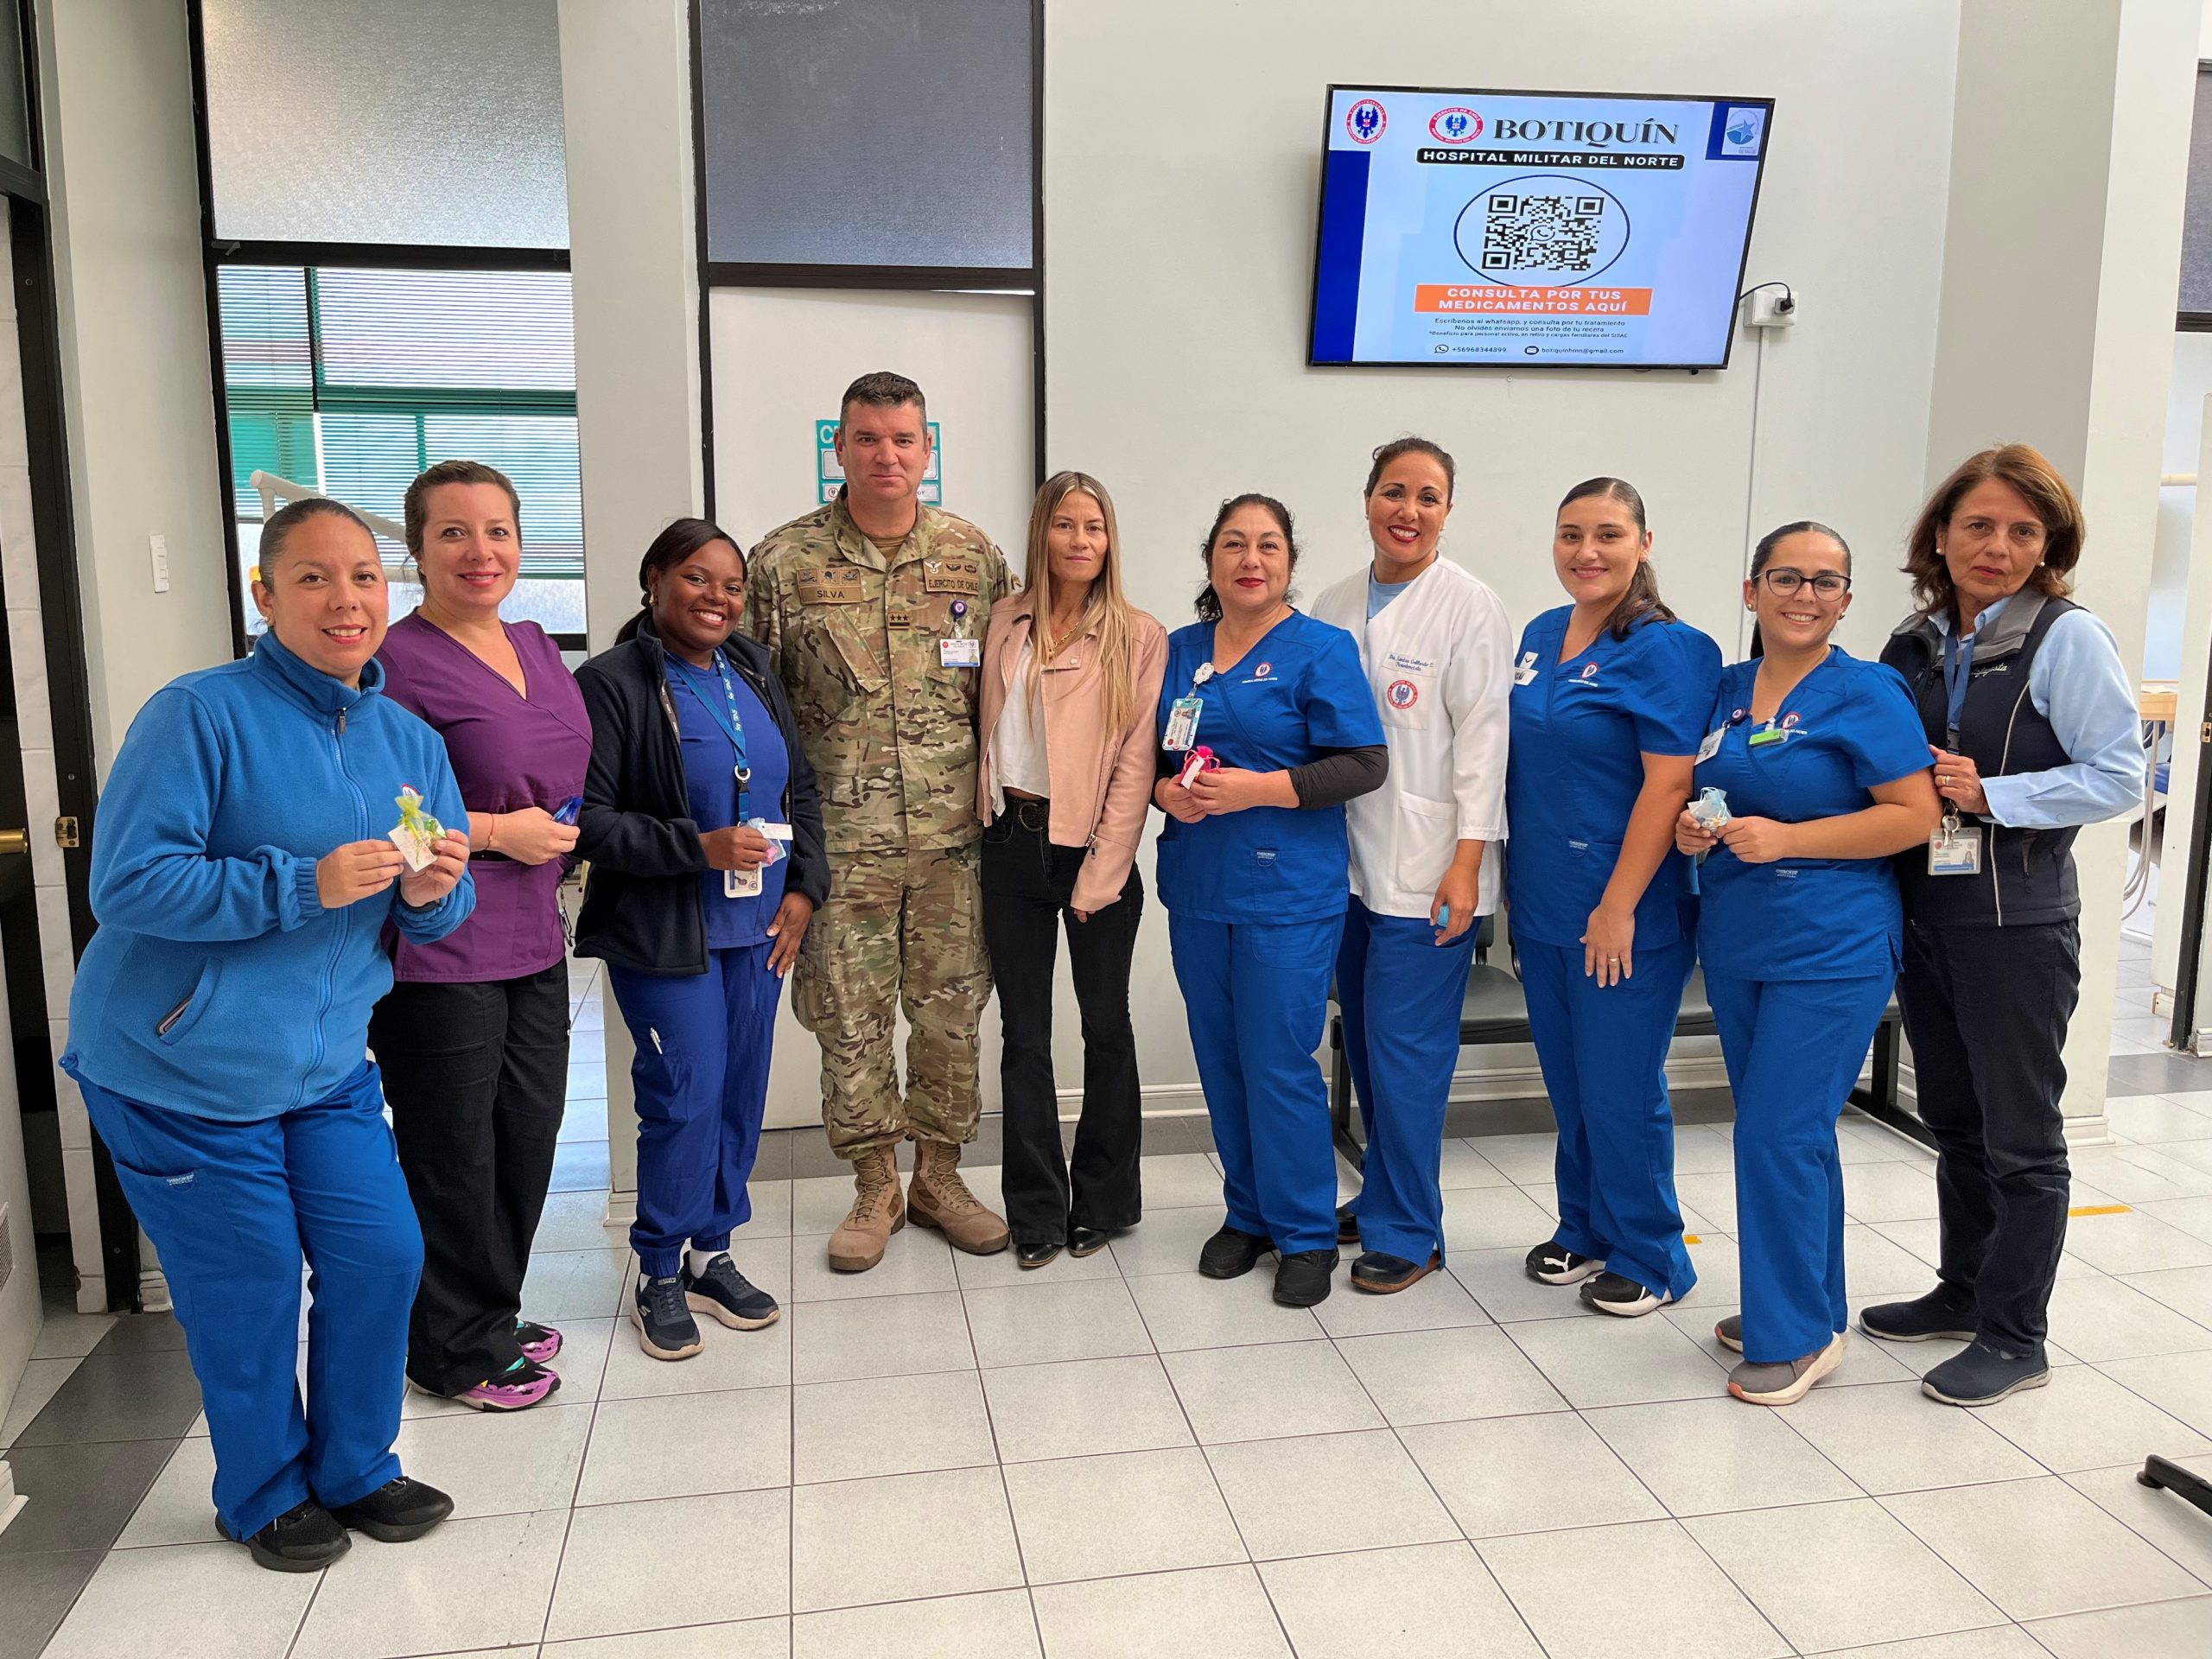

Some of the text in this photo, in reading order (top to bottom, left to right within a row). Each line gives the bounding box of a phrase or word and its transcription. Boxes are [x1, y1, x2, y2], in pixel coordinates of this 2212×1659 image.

[1493, 118, 1679, 148] BOTIQUÍN
[1423, 150, 1679, 167] HOSPITAL MILITAR DEL NORTE
[1446, 288, 1622, 300] CONSULTA POR TUS
[1439, 300, 1628, 312] MEDICAMENTOS AQUÍ
[928, 579, 979, 591] EJERCITO DE CHILE
[817, 589, 845, 600] SILVA
